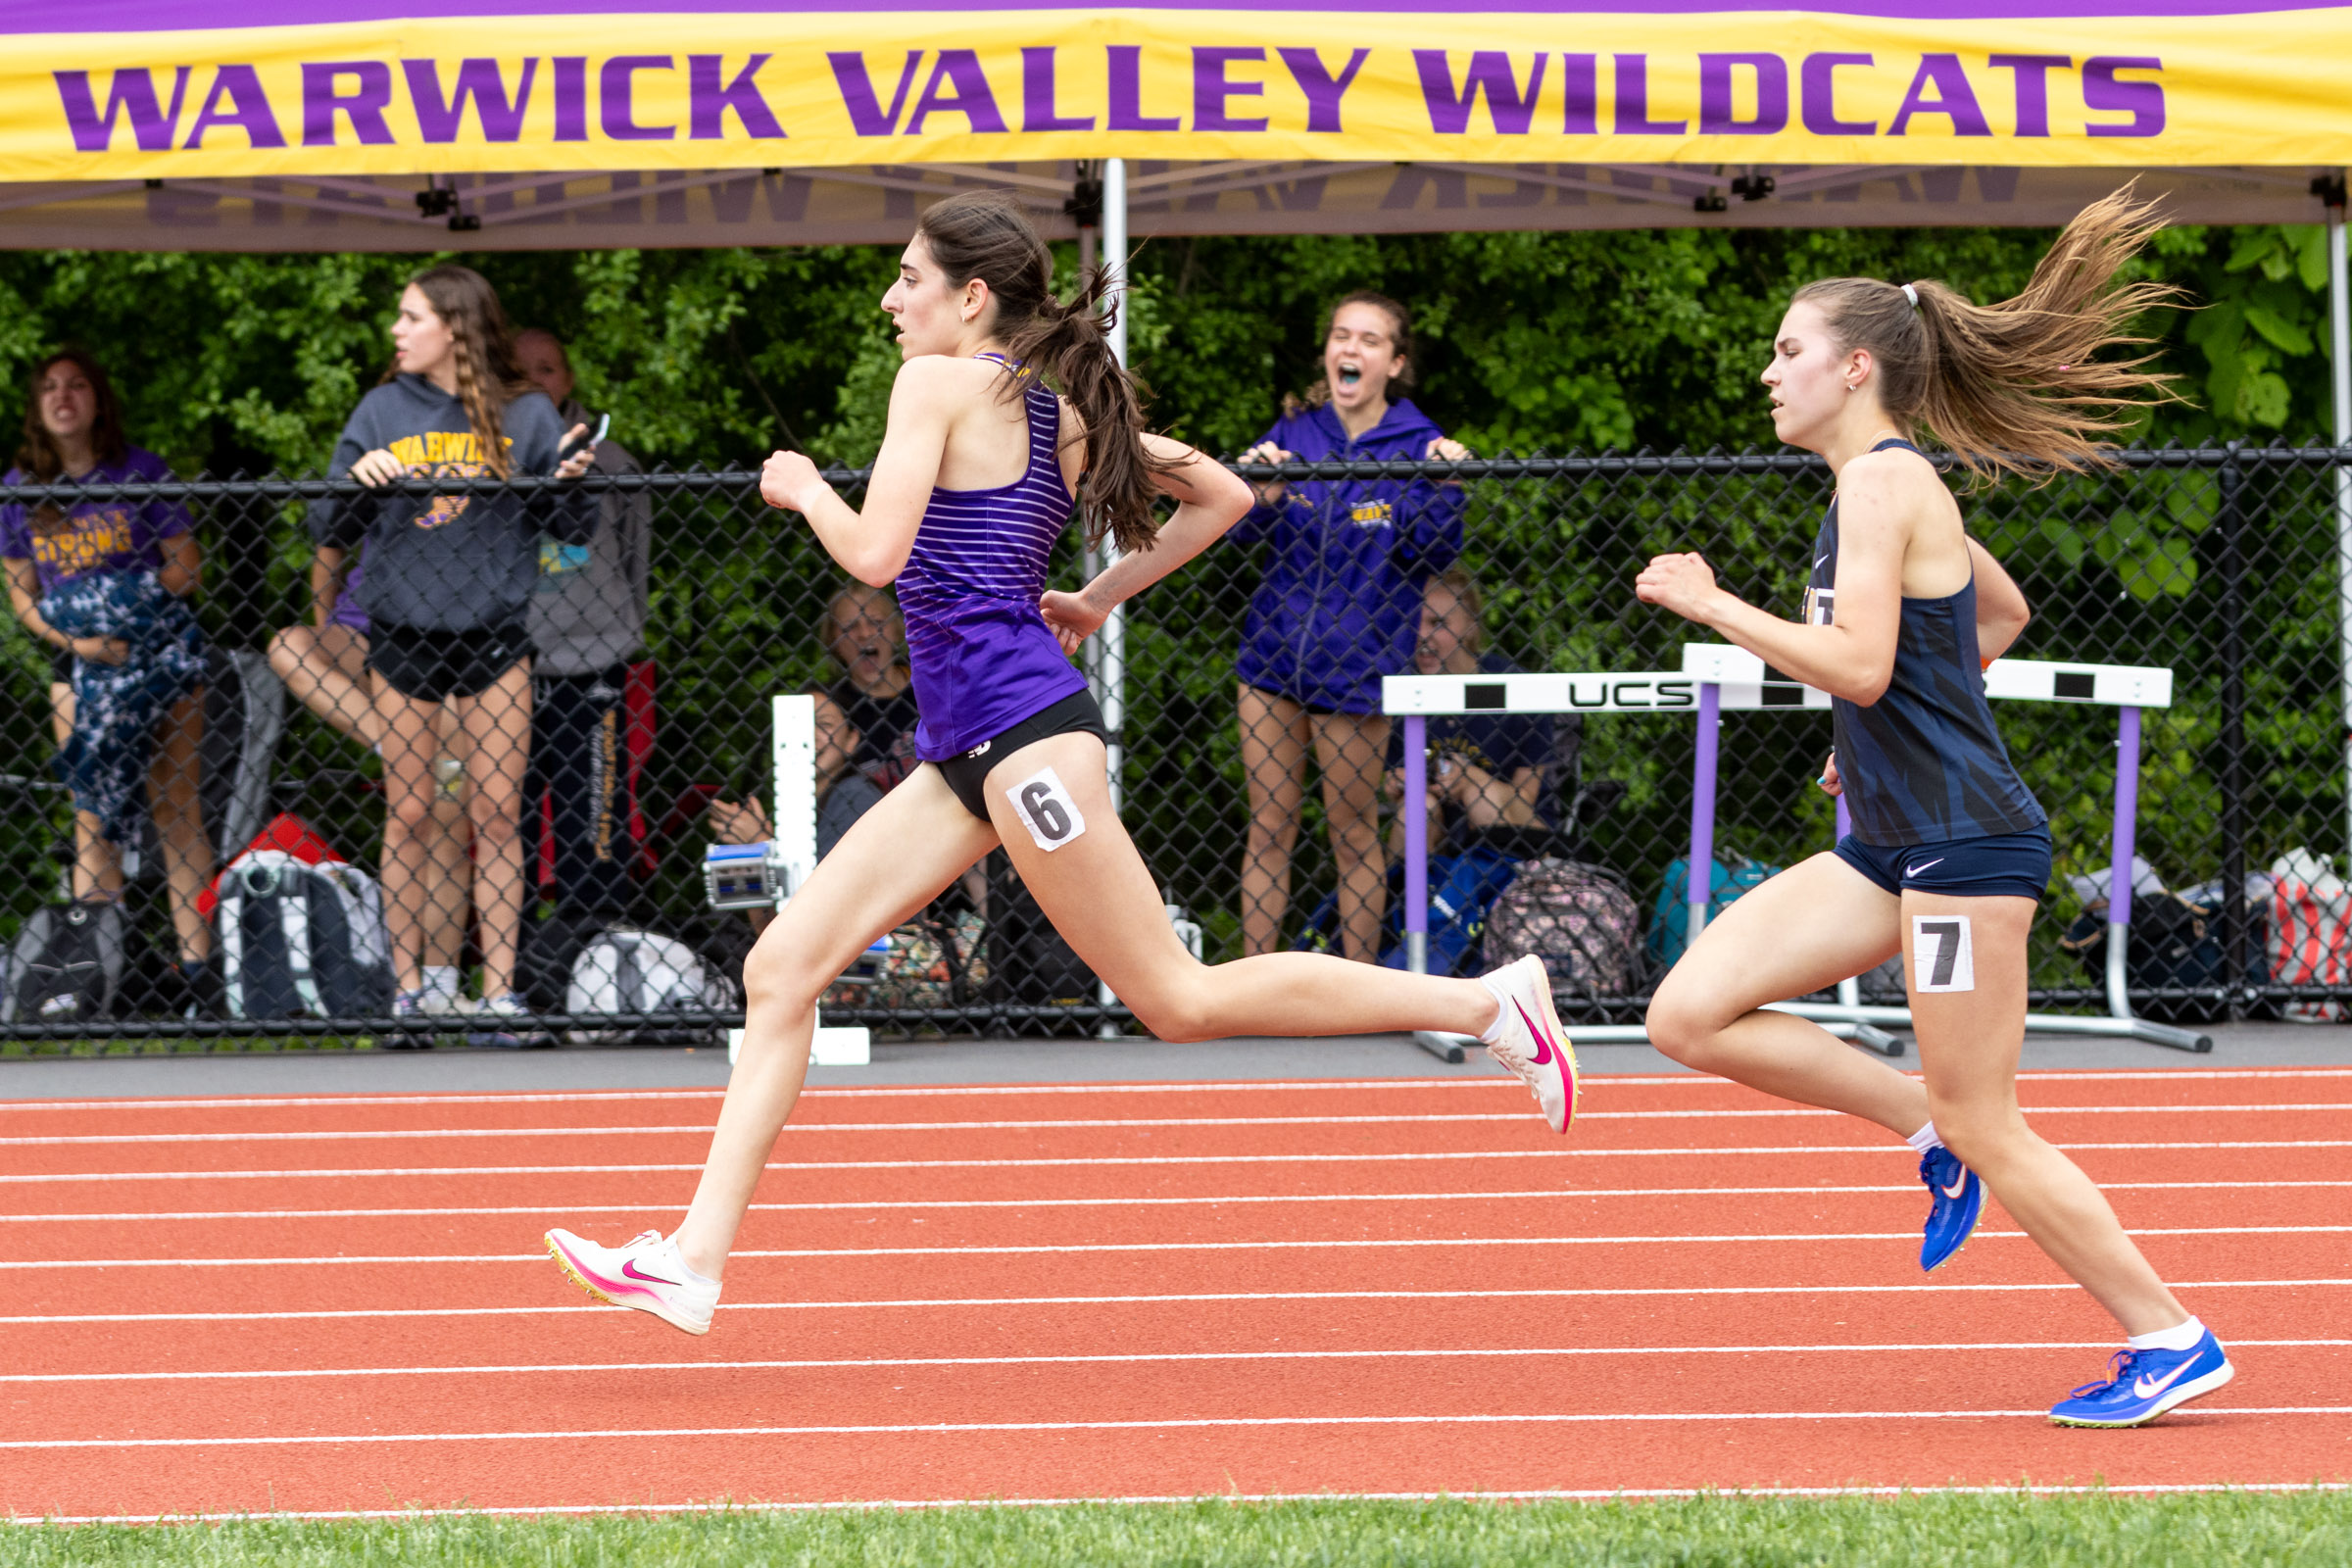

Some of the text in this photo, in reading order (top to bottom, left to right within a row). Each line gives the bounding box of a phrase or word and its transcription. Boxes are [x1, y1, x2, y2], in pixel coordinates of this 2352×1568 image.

[53, 45, 2167, 151] WARWICK VALLEY WILDCATS
[389, 431, 514, 466] WARWI
[1568, 682, 1694, 708] UCS
[1020, 781, 1072, 841] 6
[1921, 921, 1960, 986] 7
